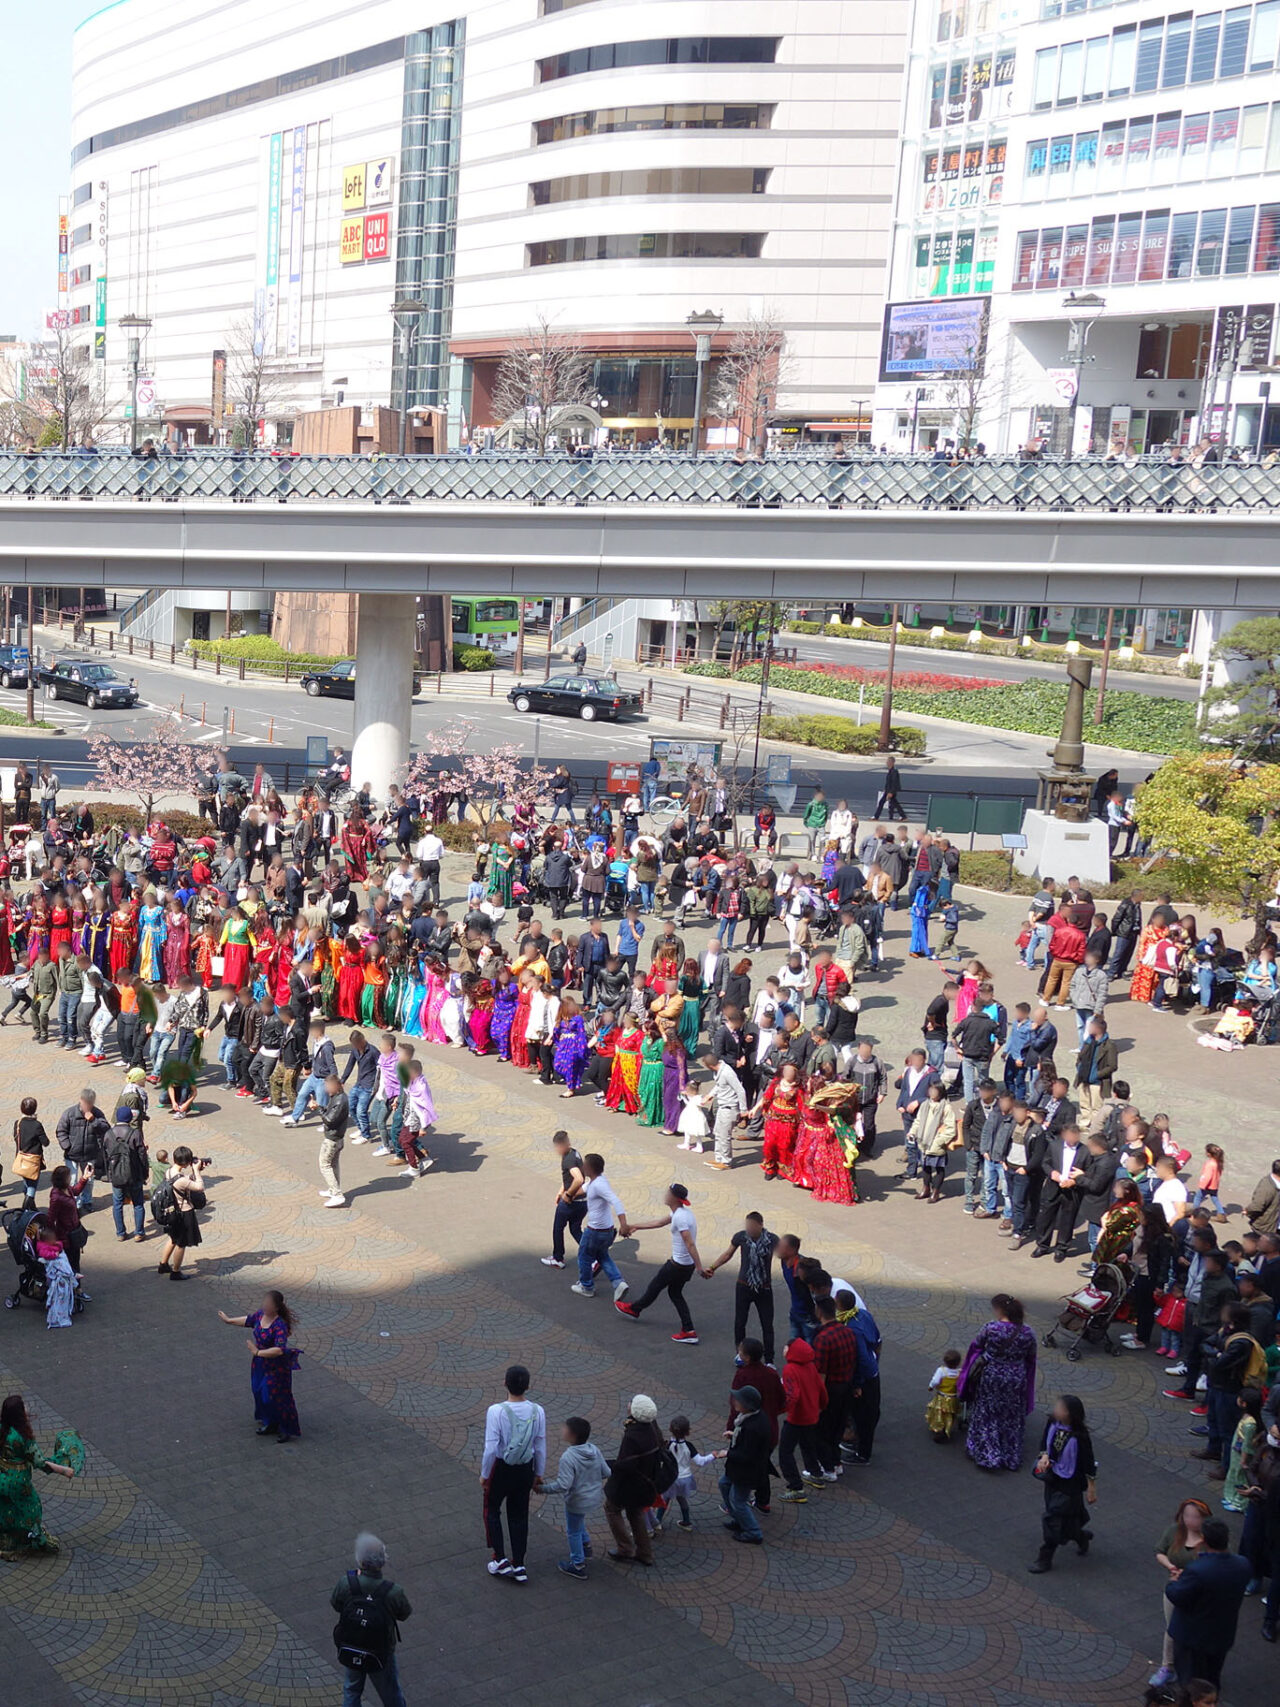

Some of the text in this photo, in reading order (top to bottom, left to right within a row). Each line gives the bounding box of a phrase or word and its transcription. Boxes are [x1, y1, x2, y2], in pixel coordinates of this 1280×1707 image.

[345, 175, 362, 198] Loft
[343, 225, 361, 243] ABC
[368, 219, 385, 235] UNI
[342, 243, 361, 255] MART
[367, 236, 385, 256] QLO
[1064, 244, 1088, 257] SUPE
[1097, 241, 1127, 254] SUTS
[1132, 237, 1164, 251] SORE
